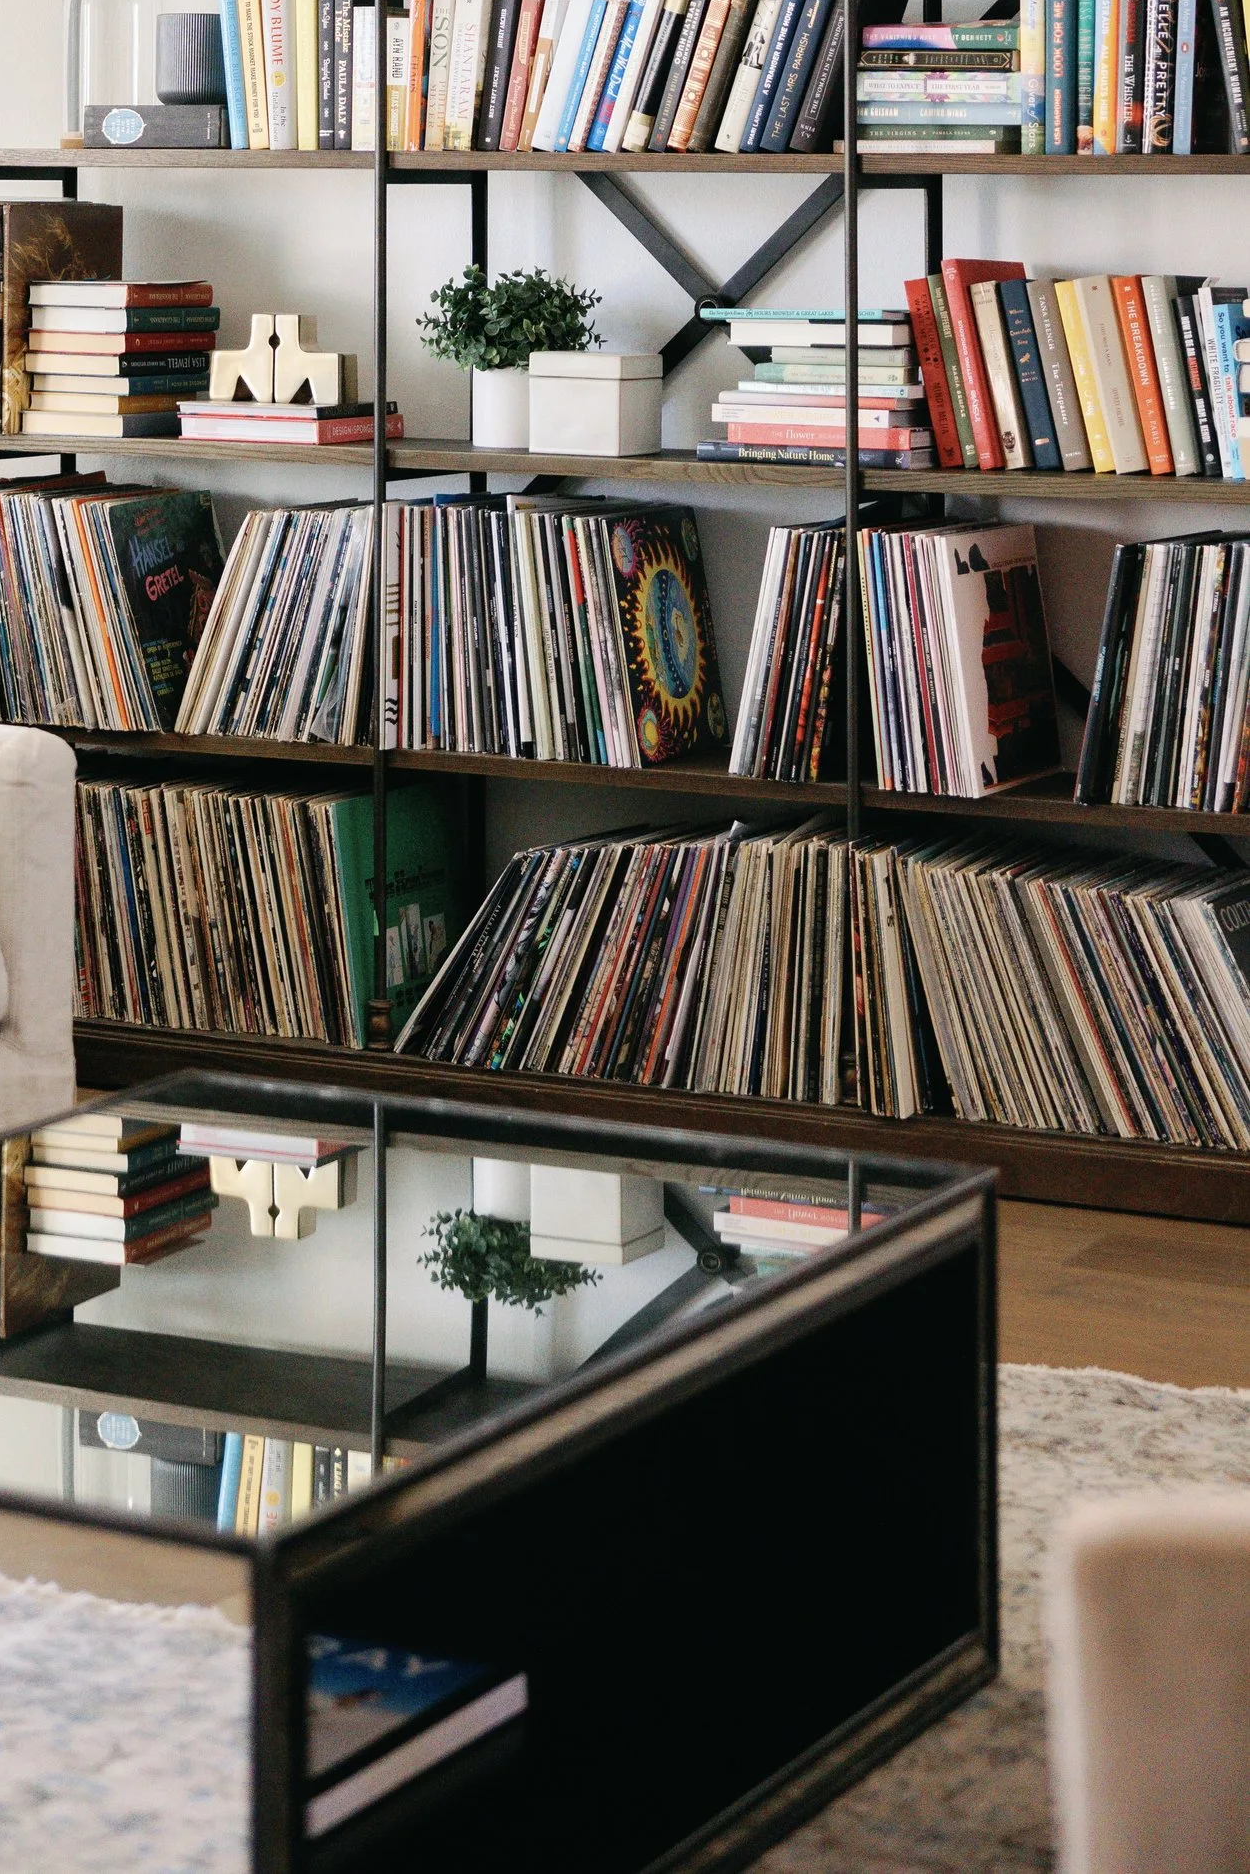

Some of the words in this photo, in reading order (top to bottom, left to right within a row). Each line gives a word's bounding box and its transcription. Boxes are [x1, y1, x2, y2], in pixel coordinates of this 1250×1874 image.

[343, 0, 351, 17] The
[682, 1, 696, 35] EVELYN
[782, 1, 795, 26] HOUSE
[1054, 1, 1064, 17] ME
[1101, 0, 1109, 34] STRAUB
[1220, 6, 1228, 16] AN
[270, 17, 283, 65] BLUME
[342, 19, 350, 53] Mistake
[393, 38, 404, 54] AYN
[619, 34, 631, 56] Man
[775, 42, 782, 50] IN
[778, 27, 788, 41] THE
[1053, 22, 1063, 44] FOR
[1079, 28, 1091, 56] ANNE
[1221, 19, 1237, 72] INCONVENIENT
[613, 56, 627, 73] Who
[674, 38, 686, 65] HUGO
[810, 100, 819, 114] THE
[815, 72, 827, 98] WOMAN
[822, 63, 829, 71] IN
[826, 48, 834, 61] THE
[831, 16, 844, 46] WINDOW
[1053, 48, 1063, 77] LOOK
[1125, 55, 1134, 72] THE
[338, 60, 347, 94] PAULA
[392, 57, 404, 78] RAND
[458, 24, 477, 120] SHANTARAM
[765, 51, 781, 88] STRANGER
[1100, 63, 1108, 97] ADULTS
[607, 76, 621, 98] Died
[772, 121, 783, 138] THE
[778, 96, 790, 118] LAST
[786, 73, 798, 92] MRS
[792, 33, 809, 69] PARRISH
[1078, 61, 1091, 106] ENRIGHT
[1155, 62, 1167, 118] PRETTY
[1230, 75, 1242, 103] WOMAN
[338, 96, 346, 124] DALY
[1054, 89, 1062, 126] GARDNER
[1123, 74, 1135, 123] WHISTLER
[747, 128, 756, 145] SHARI
[753, 104, 764, 127] LAPENA
[1039, 295, 1048, 316] TANA
[1127, 300, 1136, 319] THE
[1218, 312, 1224, 323] So
[1043, 319, 1054, 350] FRENCH
[1217, 325, 1226, 340] you
[168, 356, 191, 368] JEWELL
[193, 358, 205, 367] LISA
[1130, 322, 1150, 386] BREAKDOWN
[1207, 338, 1217, 364] WHITE
[1052, 362, 1061, 379] The
[1223, 364, 1230, 372] to
[951, 365, 960, 388] MARIA
[956, 391, 966, 418] SEMPLE
[1210, 367, 1223, 405] FRAGILITY
[1225, 377, 1234, 392] talk
[1055, 382, 1069, 425] Trespasser
[1226, 395, 1236, 418] about
[1229, 420, 1237, 438] race
[738, 448, 776, 460] Bringing
[778, 450, 807, 460] Nature
[809, 451, 834, 461] Home
[128, 535, 174, 578] HANSEL
[145, 565, 184, 602] GRETEL
